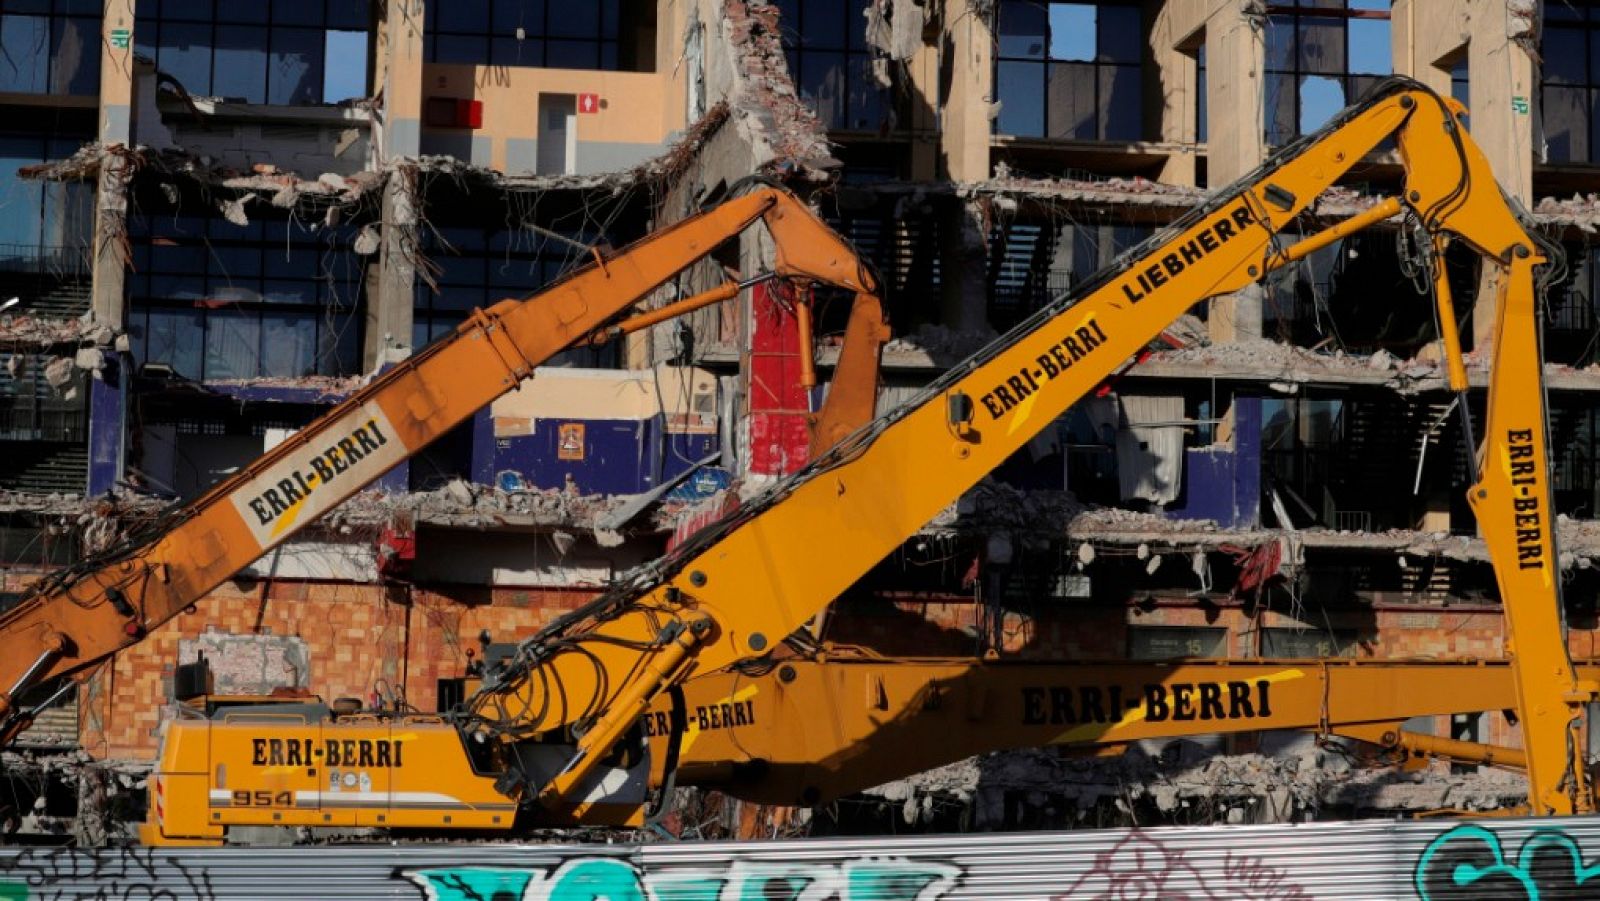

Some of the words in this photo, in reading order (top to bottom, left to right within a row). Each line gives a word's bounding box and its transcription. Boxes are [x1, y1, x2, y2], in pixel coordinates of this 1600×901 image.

[1121, 205, 1254, 304] LIEBHERR
[980, 318, 1108, 420] ERRI-BERRI
[248, 419, 387, 526] ERRI-BERRI
[1508, 428, 1544, 570] ERRI-BERRI
[1186, 640, 1202, 655] 15
[643, 701, 755, 737] ER-BERRI
[1021, 680, 1272, 725] ERRI-BERRI
[252, 738, 402, 768] ERRI-BERRI
[233, 790, 295, 806] 954
